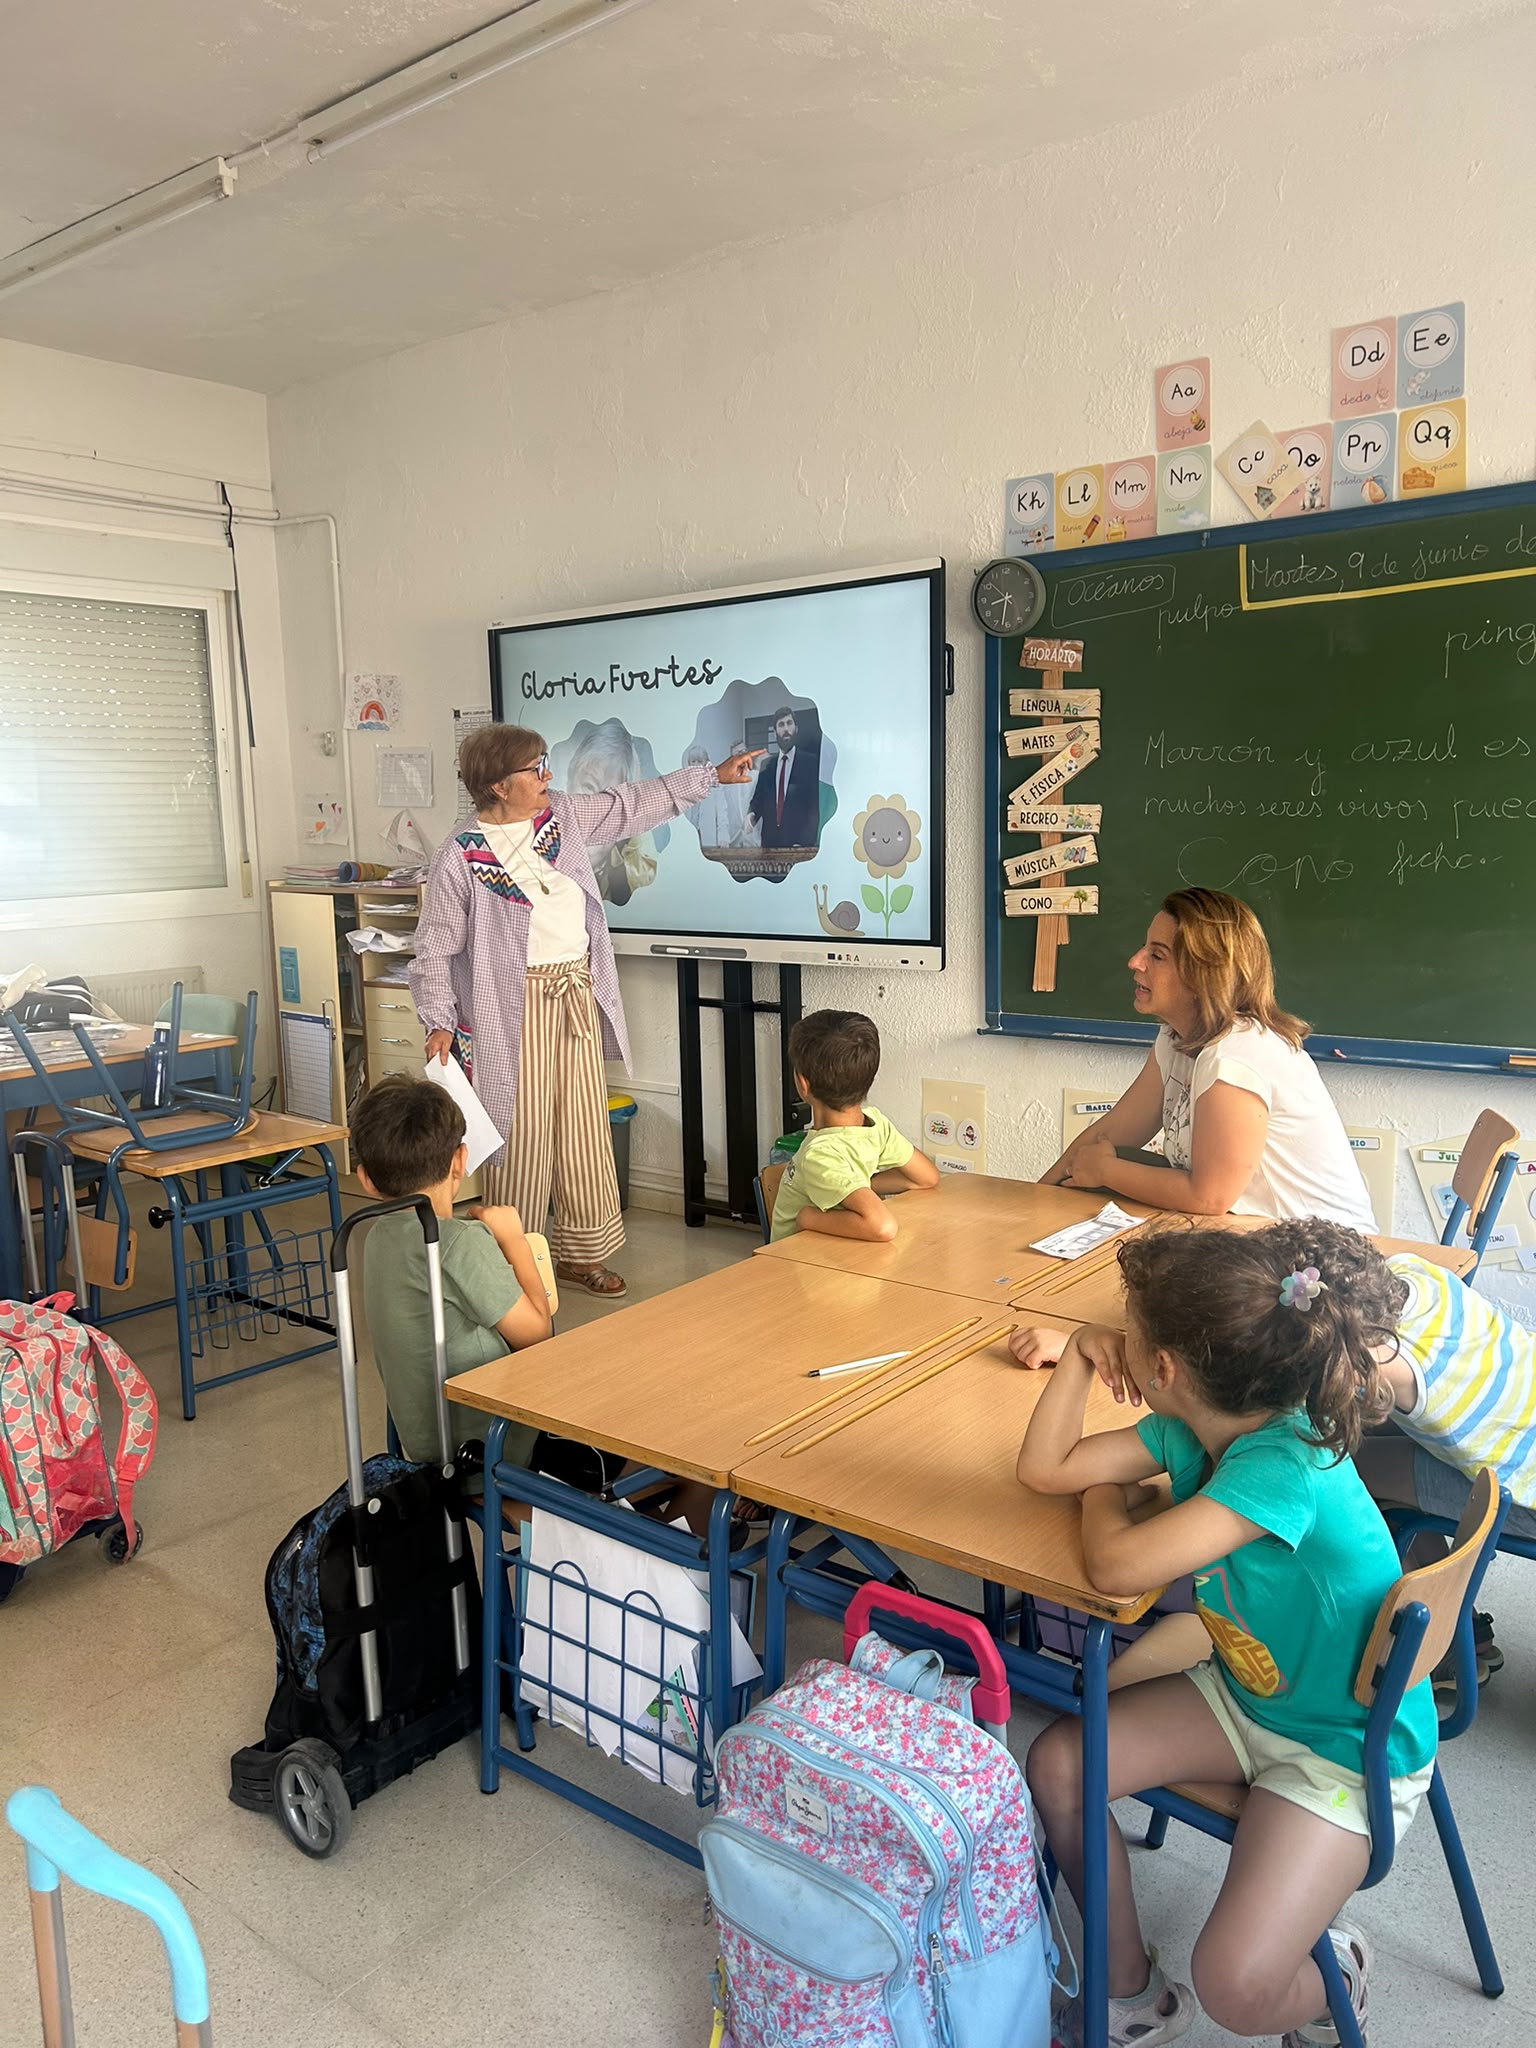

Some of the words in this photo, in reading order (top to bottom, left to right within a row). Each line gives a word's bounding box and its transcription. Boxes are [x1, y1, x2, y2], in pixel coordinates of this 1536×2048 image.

[1413, 327, 1451, 352] Ee
[1351, 341, 1385, 367] Dd
[1170, 383, 1197, 400] Aa
[1340, 391, 1372, 406] dedo
[1163, 426, 1193, 440] abeja
[1414, 420, 1451, 448] Qq
[1347, 434, 1381, 463] Pp
[1170, 466, 1202, 486] Nn
[1266, 464, 1289, 485] casa
[1068, 483, 1092, 505] Ll
[1114, 479, 1147, 496] Mm
[1348, 551, 1366, 579] 9
[1370, 551, 1401, 579] de
[1411, 533, 1490, 581] junio
[1067, 573, 1165, 606] Océanos
[1158, 592, 1237, 639] pulpo
[1029, 647, 1077, 664] HORARIO
[521, 670, 606, 701] Gloria
[609, 654, 723, 693] Fuertes
[1021, 698, 1061, 713] LENGUA
[1021, 734, 1056, 750] MATES
[1144, 729, 1275, 768] Marrón
[1295, 748, 1326, 796] y
[1351, 723, 1457, 762] azul
[1029, 767, 1066, 800] FÍSICA
[1144, 784, 1247, 815] muchos
[1256, 800, 1322, 818] seres
[1338, 788, 1428, 821] vivos
[1020, 811, 1059, 825] RECREO
[1014, 855, 1057, 878] MÚSICA
[1020, 896, 1053, 910] CONO
